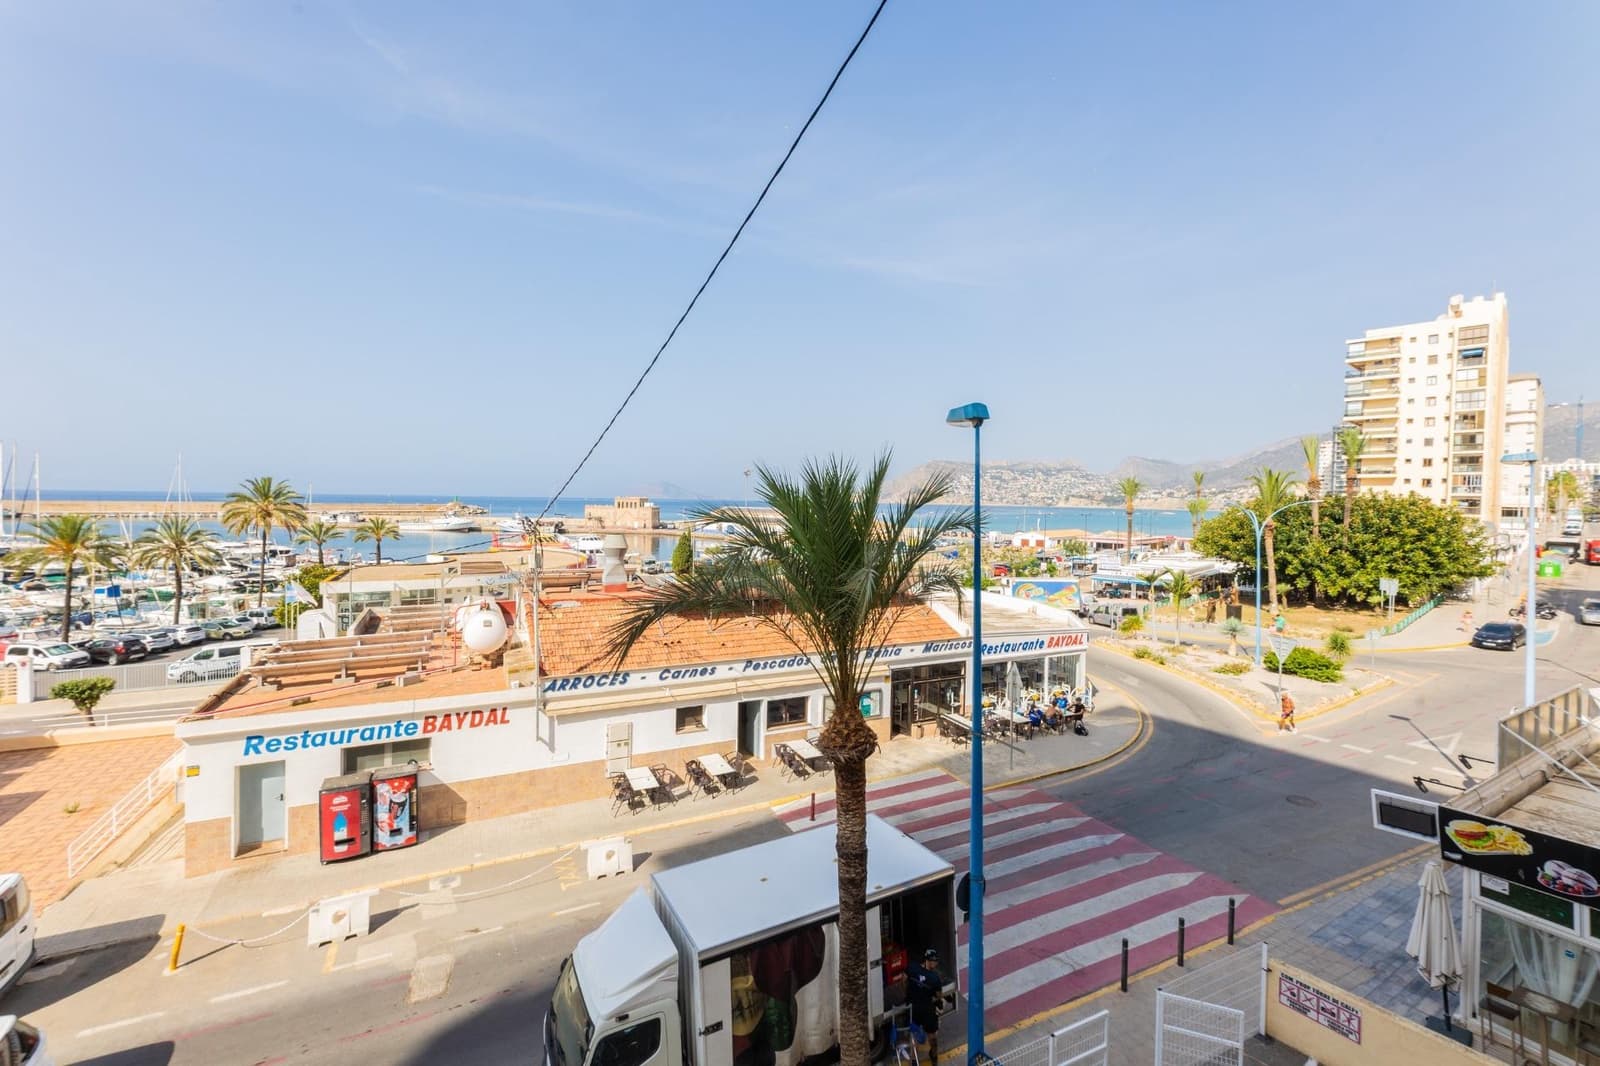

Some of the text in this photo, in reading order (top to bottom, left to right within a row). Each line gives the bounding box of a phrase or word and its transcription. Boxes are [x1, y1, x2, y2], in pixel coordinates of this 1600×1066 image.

[542, 672, 631, 693] ARROCES
[658, 666, 717, 681] Carnes
[743, 655, 811, 672] Pescados
[922, 640, 973, 654] Mariscos
[981, 634, 1084, 655] Restaurante BAYDAL
[243, 707, 510, 756] Restaurante BAYDAL
